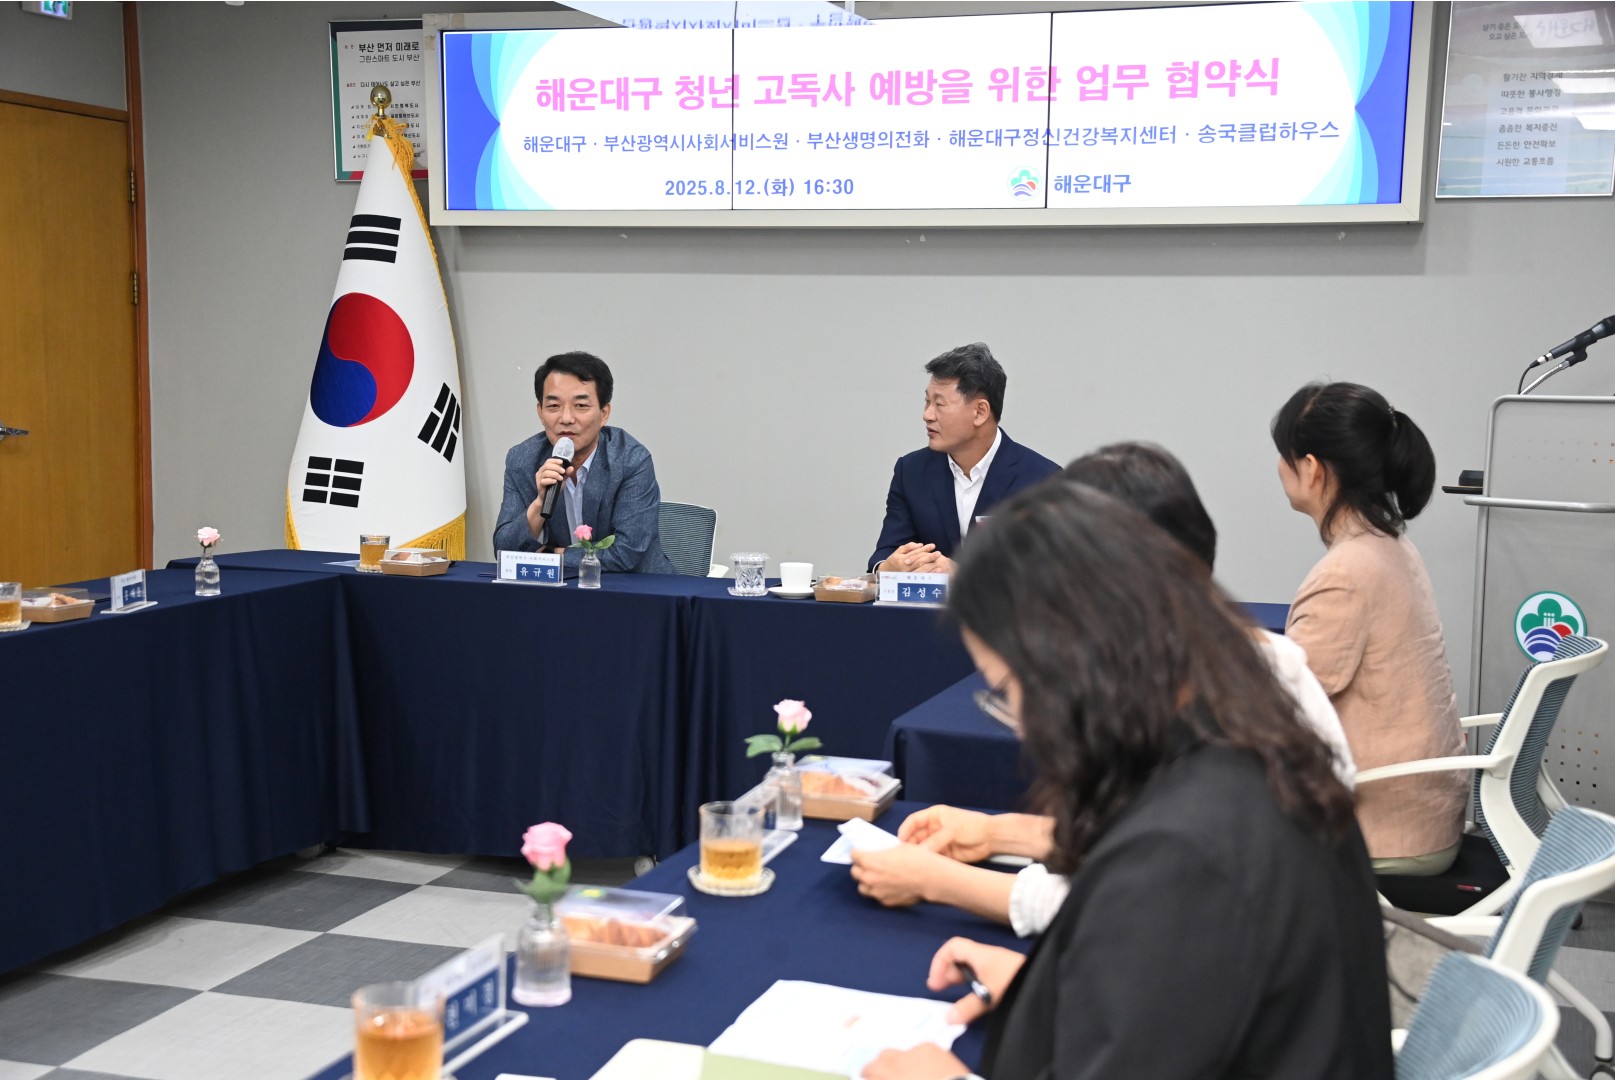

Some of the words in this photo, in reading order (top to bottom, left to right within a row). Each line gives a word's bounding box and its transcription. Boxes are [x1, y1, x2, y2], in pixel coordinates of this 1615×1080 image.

[358, 43, 375, 52] 부산
[377, 42, 393, 52] 먼저
[395, 41, 420, 51] 미래로
[359, 55, 390, 63] 그린스마트
[392, 54, 405, 62] 도시
[536, 77, 662, 112] 해운대구
[676, 74, 739, 110] 청년
[754, 72, 855, 107] 고독사
[870, 70, 972, 105] 예방을
[988, 66, 1061, 102] 위한
[1077, 64, 1149, 100] 업무
[1166, 57, 1280, 98] 협약식
[1500, 90, 1525, 99] 따뜻한
[524, 136, 586, 153] 해운대구
[604, 132, 788, 153] 부산광역시사회서비스원
[807, 130, 930, 151] 부산생명의전화
[949, 125, 1176, 148] 해운대구정신건강복지센터
[1198, 121, 1340, 144] 송국클럽하우스
[1497, 141, 1520, 150] 든든한
[1523, 140, 1557, 149] 안전확보
[1496, 158, 1520, 166] 시원한
[1523, 156, 1554, 166] 교통흐름
[665, 178, 795, 197] 2025.8.12.(화)
[804, 178, 854, 195] 16:30
[1054, 174, 1132, 194] 해운대구
[519, 566, 555, 579] 유규원
[902, 586, 942, 598] 김성수
